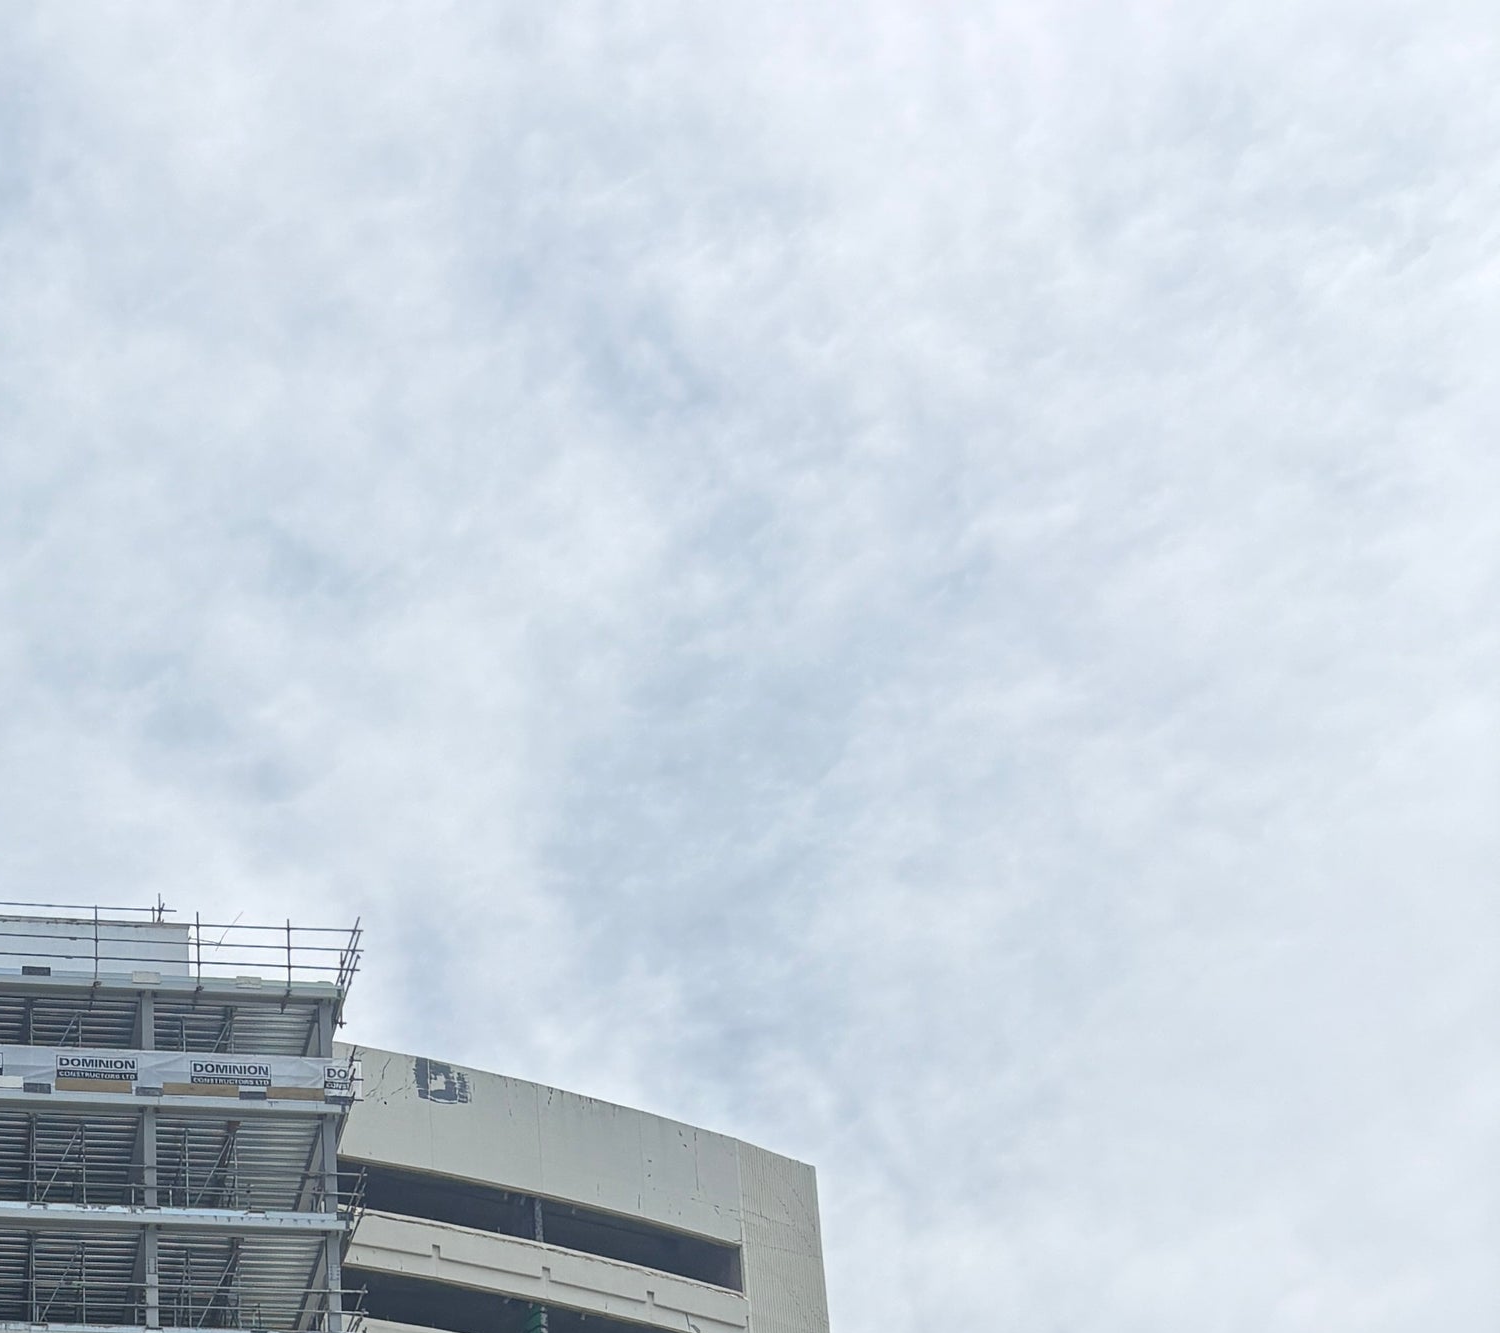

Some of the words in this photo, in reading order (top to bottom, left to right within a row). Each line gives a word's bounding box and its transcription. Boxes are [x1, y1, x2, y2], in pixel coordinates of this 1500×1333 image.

[59, 1057, 136, 1070] DOMINION
[192, 1063, 270, 1076] DOMINION
[120, 1073, 136, 1081] LTD
[254, 1079, 270, 1087] LTD
